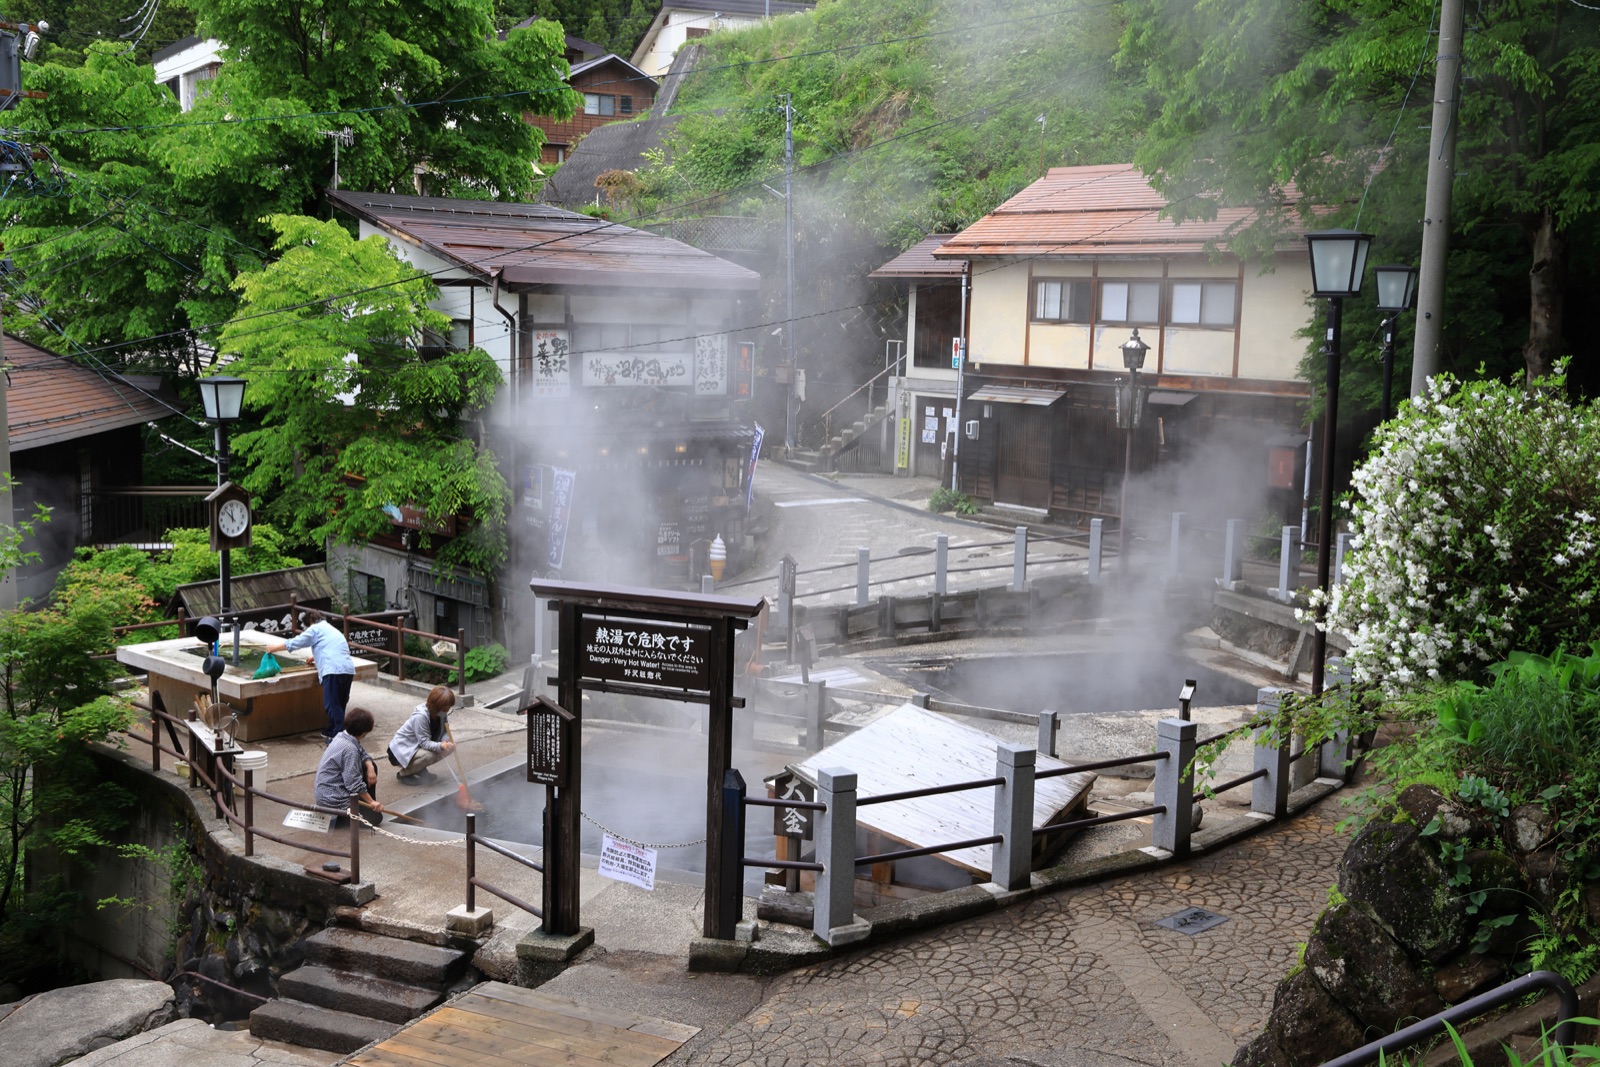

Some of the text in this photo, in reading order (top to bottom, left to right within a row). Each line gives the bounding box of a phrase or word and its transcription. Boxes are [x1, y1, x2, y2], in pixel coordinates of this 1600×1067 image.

[595, 627, 694, 652] 熱湯で危険です
[586, 644, 704, 664] 地元の人以外は中に入らないでください
[628, 658, 639, 666] Hot
[640, 659, 660, 669] Water!
[624, 668, 662, 681] 野沢組惣代
